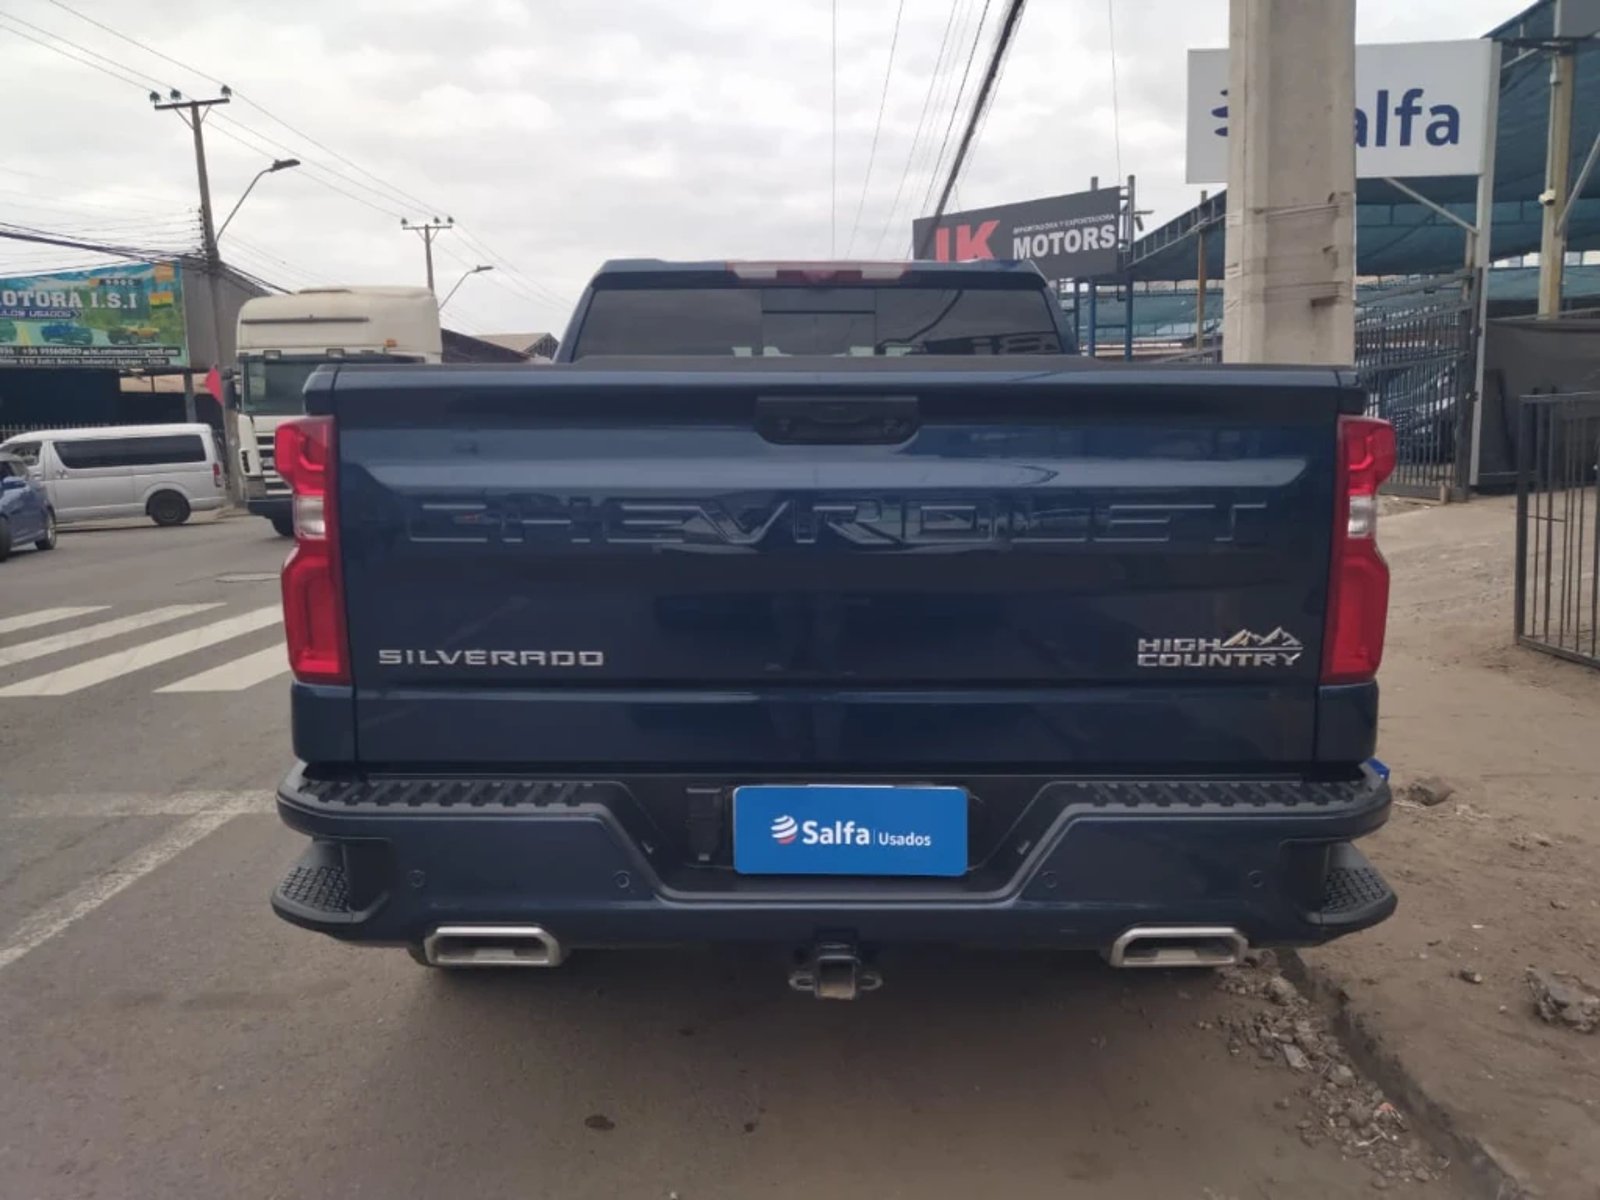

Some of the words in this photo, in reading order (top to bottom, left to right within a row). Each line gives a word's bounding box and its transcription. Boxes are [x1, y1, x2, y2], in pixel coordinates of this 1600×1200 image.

[1355, 88, 1460, 147] lfa
[1013, 224, 1116, 260] MOTORS
[0, 290, 83, 308] OTORA
[408, 500, 1267, 543] CHEVROLET
[1138, 638, 1221, 652] HIGH
[378, 649, 605, 667] SILVERADO
[1137, 652, 1302, 667] COUNTRY
[802, 819, 871, 846] Salfa
[878, 831, 932, 847] Usados
